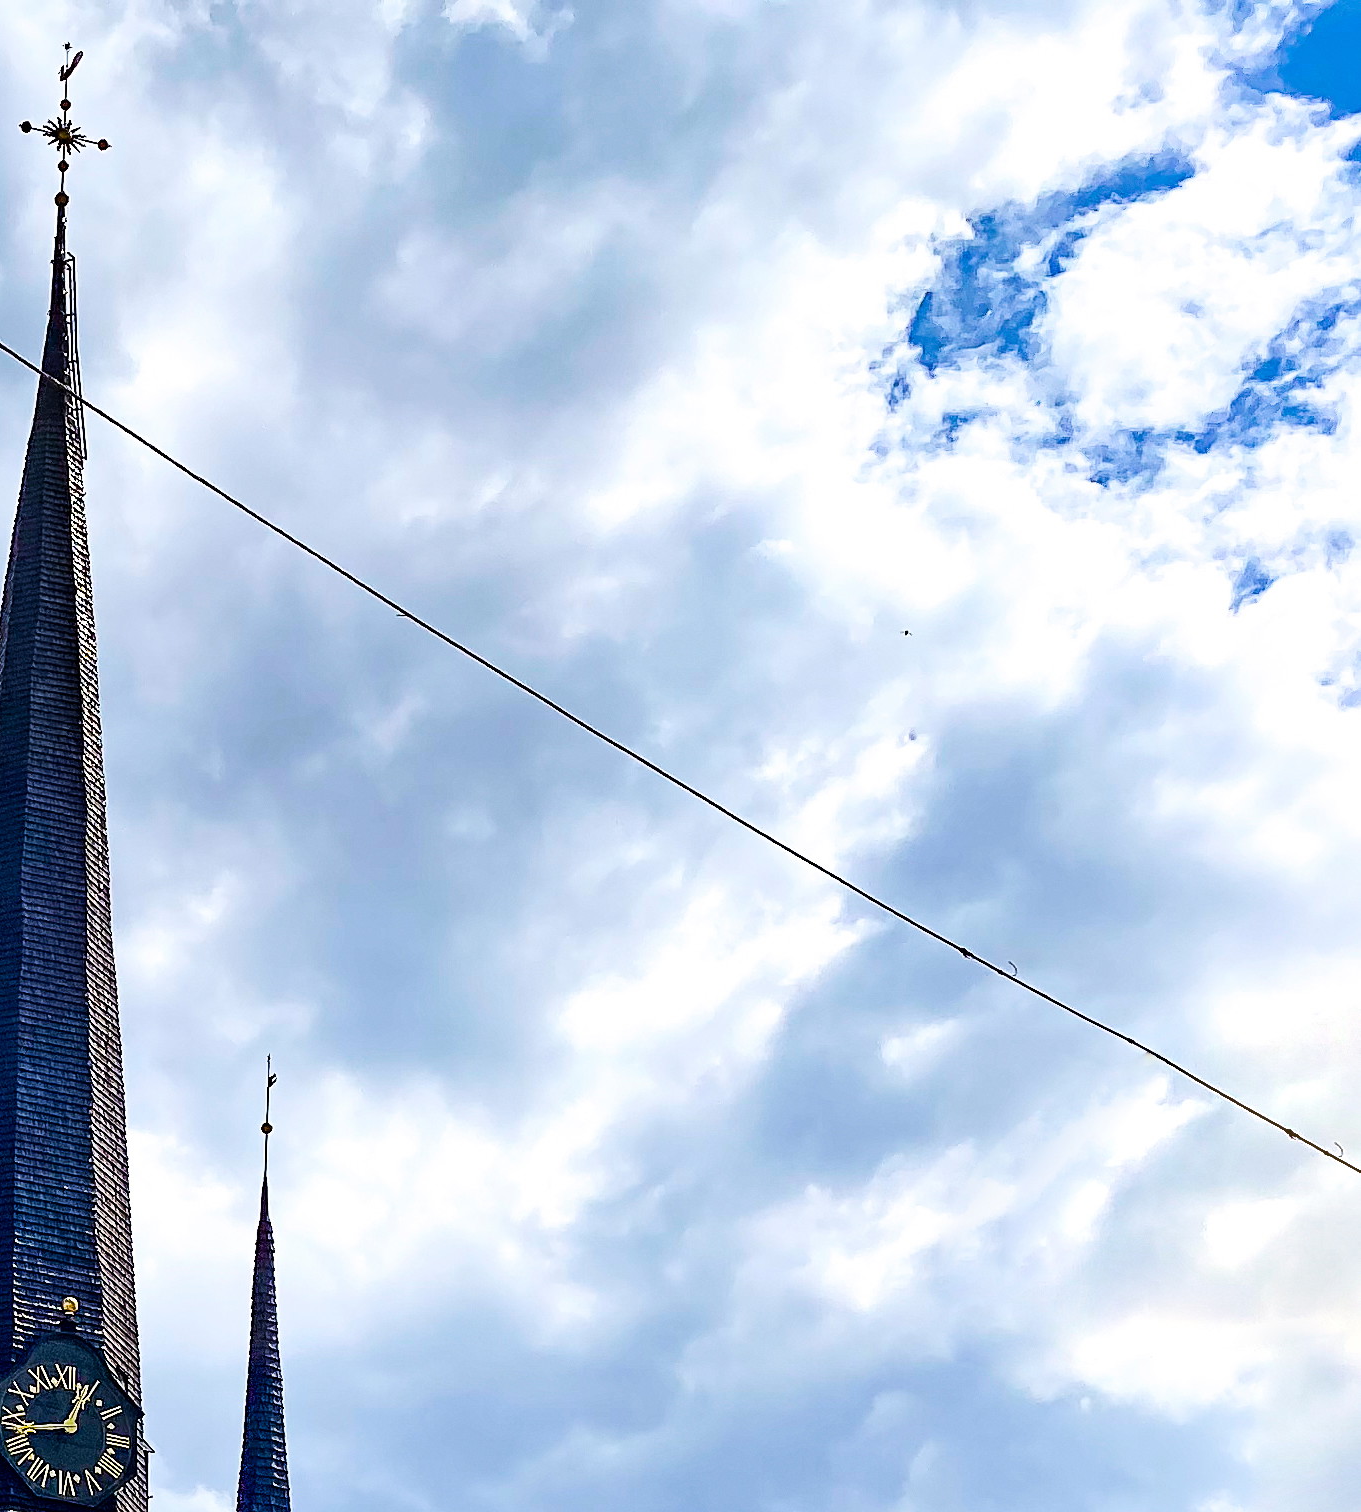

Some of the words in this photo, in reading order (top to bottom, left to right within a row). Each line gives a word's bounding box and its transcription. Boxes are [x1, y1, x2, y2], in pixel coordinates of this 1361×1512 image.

[27, 1364, 54, 1394] XI
[55, 1363, 77, 1391] XII
[7, 1380, 35, 1407] X
[99, 1405, 123, 1421] II
[5, 1433, 34, 1466] VIII
[105, 1432, 131, 1449] III
[26, 1456, 50, 1488] VII
[97, 1452, 125, 1479] IIII
[58, 1469, 76, 1497] VI
[84, 1469, 103, 1496] V
